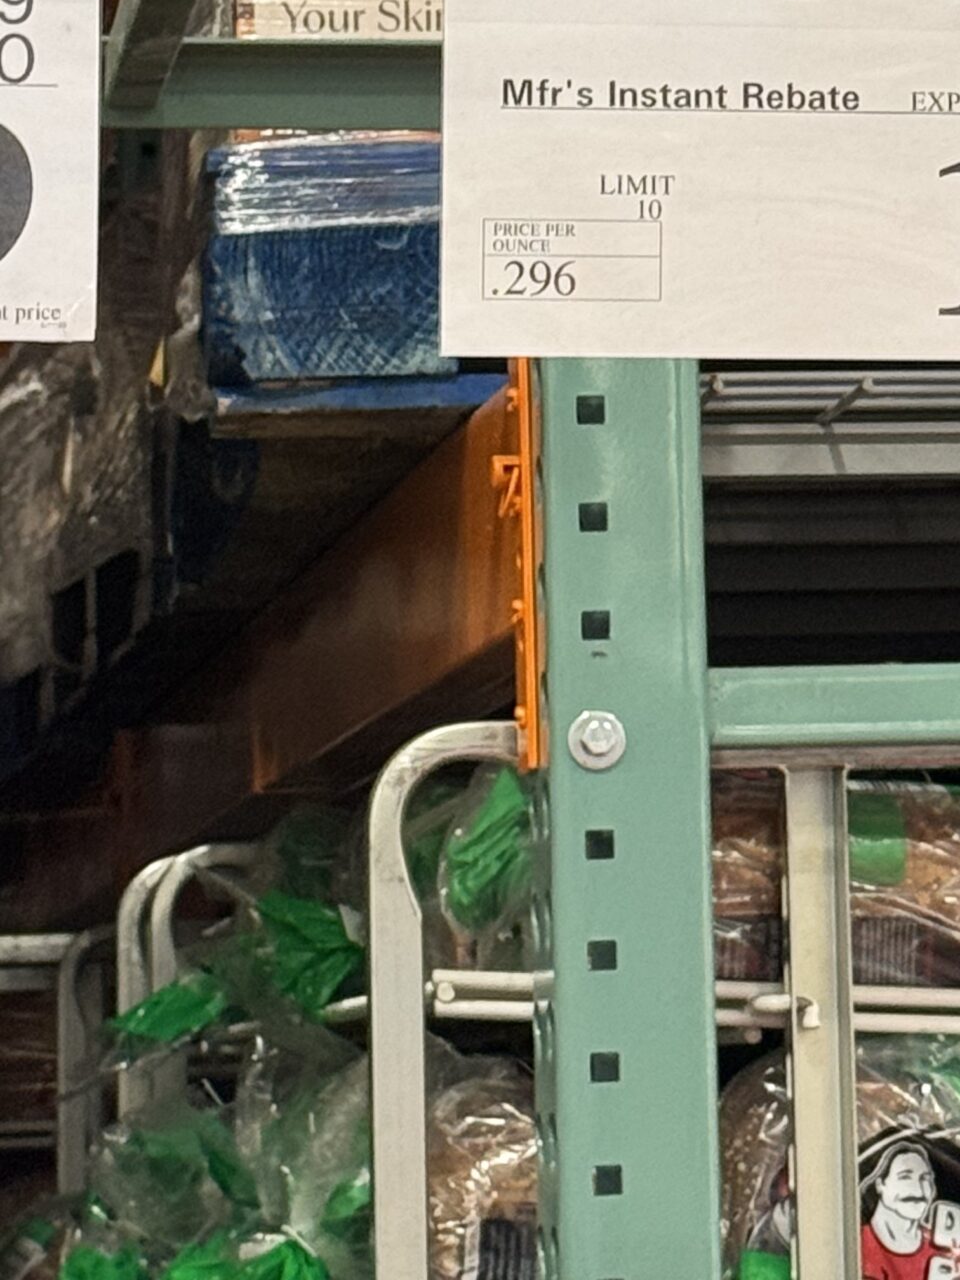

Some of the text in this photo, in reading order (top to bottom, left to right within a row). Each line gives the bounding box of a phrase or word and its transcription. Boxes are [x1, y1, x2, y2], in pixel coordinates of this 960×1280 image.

[281, 0, 367, 33] Your
[501, 78, 593, 109] Mfr's
[609, 80, 728, 109] Instant
[742, 82, 860, 111] Rebate
[599, 174, 676, 197] LIMIT
[638, 199, 663, 221] 10
[492, 222, 577, 238] PRICE PER
[492, 238, 551, 253] OUNCE
[491, 260, 577, 296] .296
[15, 302, 62, 325] price
